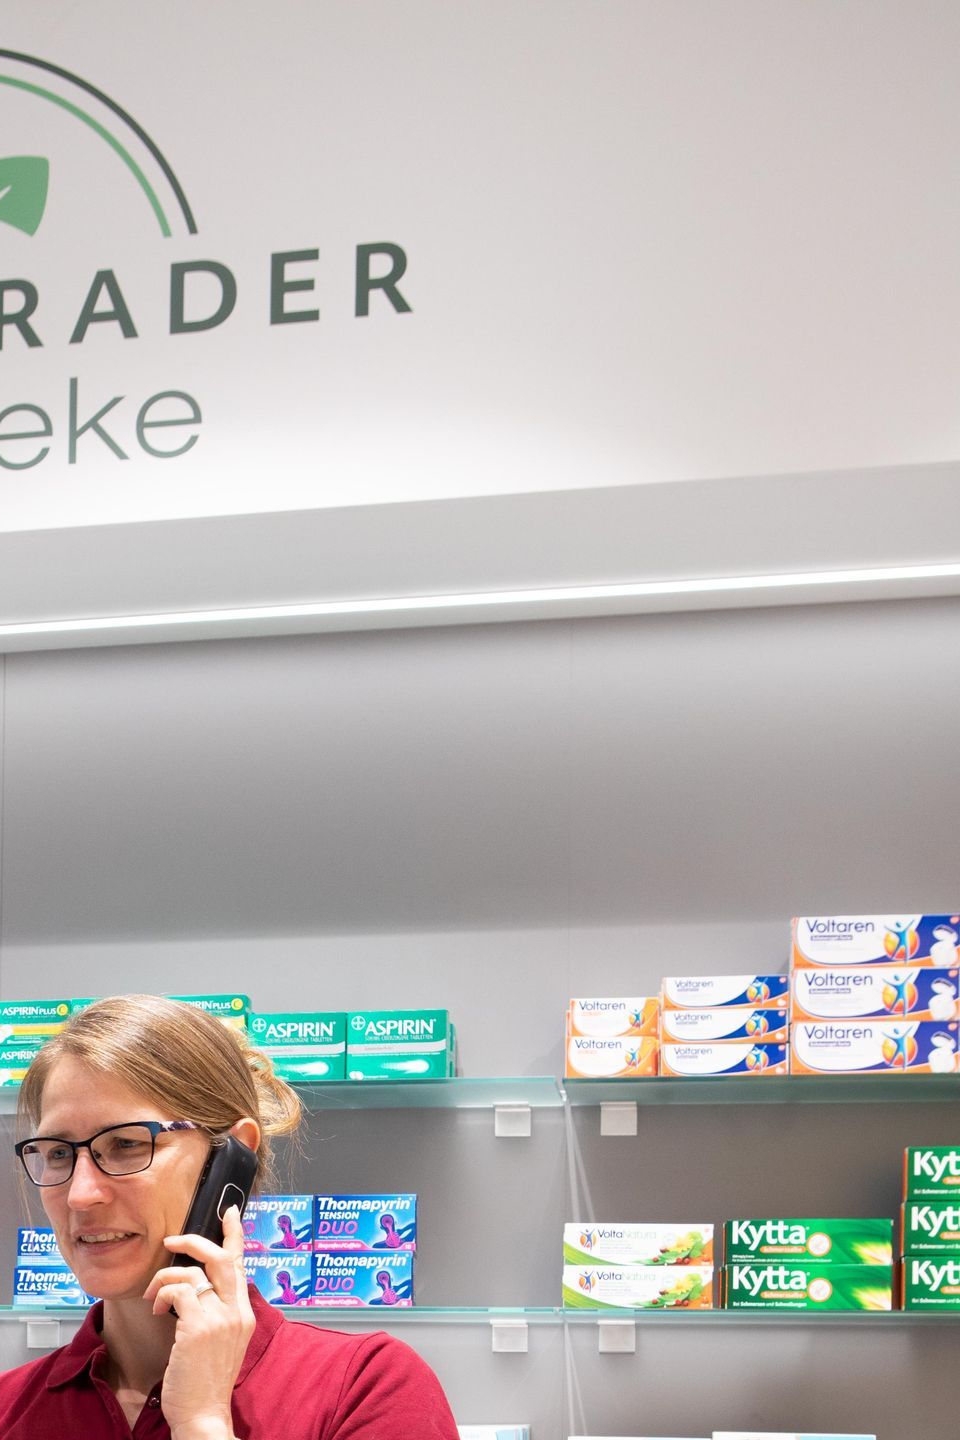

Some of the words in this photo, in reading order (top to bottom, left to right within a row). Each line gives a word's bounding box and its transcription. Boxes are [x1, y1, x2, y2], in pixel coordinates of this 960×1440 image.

[806, 919, 874, 933] Voltaren
[675, 980, 713, 988] Voltaren
[804, 973, 873, 986] Voltaren
[2, 1007, 40, 1016] ASPIRIN
[579, 1001, 626, 1011] Voltaren
[674, 1013, 712, 1021] Voltaren
[265, 1022, 333, 1038] ASPIRIN
[365, 1019, 434, 1035] ASPIRIN
[805, 1025, 872, 1039] Voltaren
[575, 1039, 622, 1050] Voltaren
[674, 1047, 712, 1056] Voltaren
[0, 1051, 37, 1060] ASPIRIN
[914, 1151, 960, 1182] Kyt
[245, 1199, 307, 1213] mapyrin
[318, 1197, 410, 1212] Thomapyrin
[318, 1221, 358, 1235] DUO
[911, 1206, 960, 1237] Kyt
[732, 1220, 806, 1251] Kytta
[243, 1254, 306, 1268] mapyrin
[315, 1254, 406, 1269] Thomapyrin
[316, 1268, 356, 1276] TENSION
[911, 1260, 960, 1292] Kyt
[17, 1283, 58, 1291] CLASSIC
[315, 1277, 354, 1291] DUO
[732, 1266, 806, 1296] Kytta
